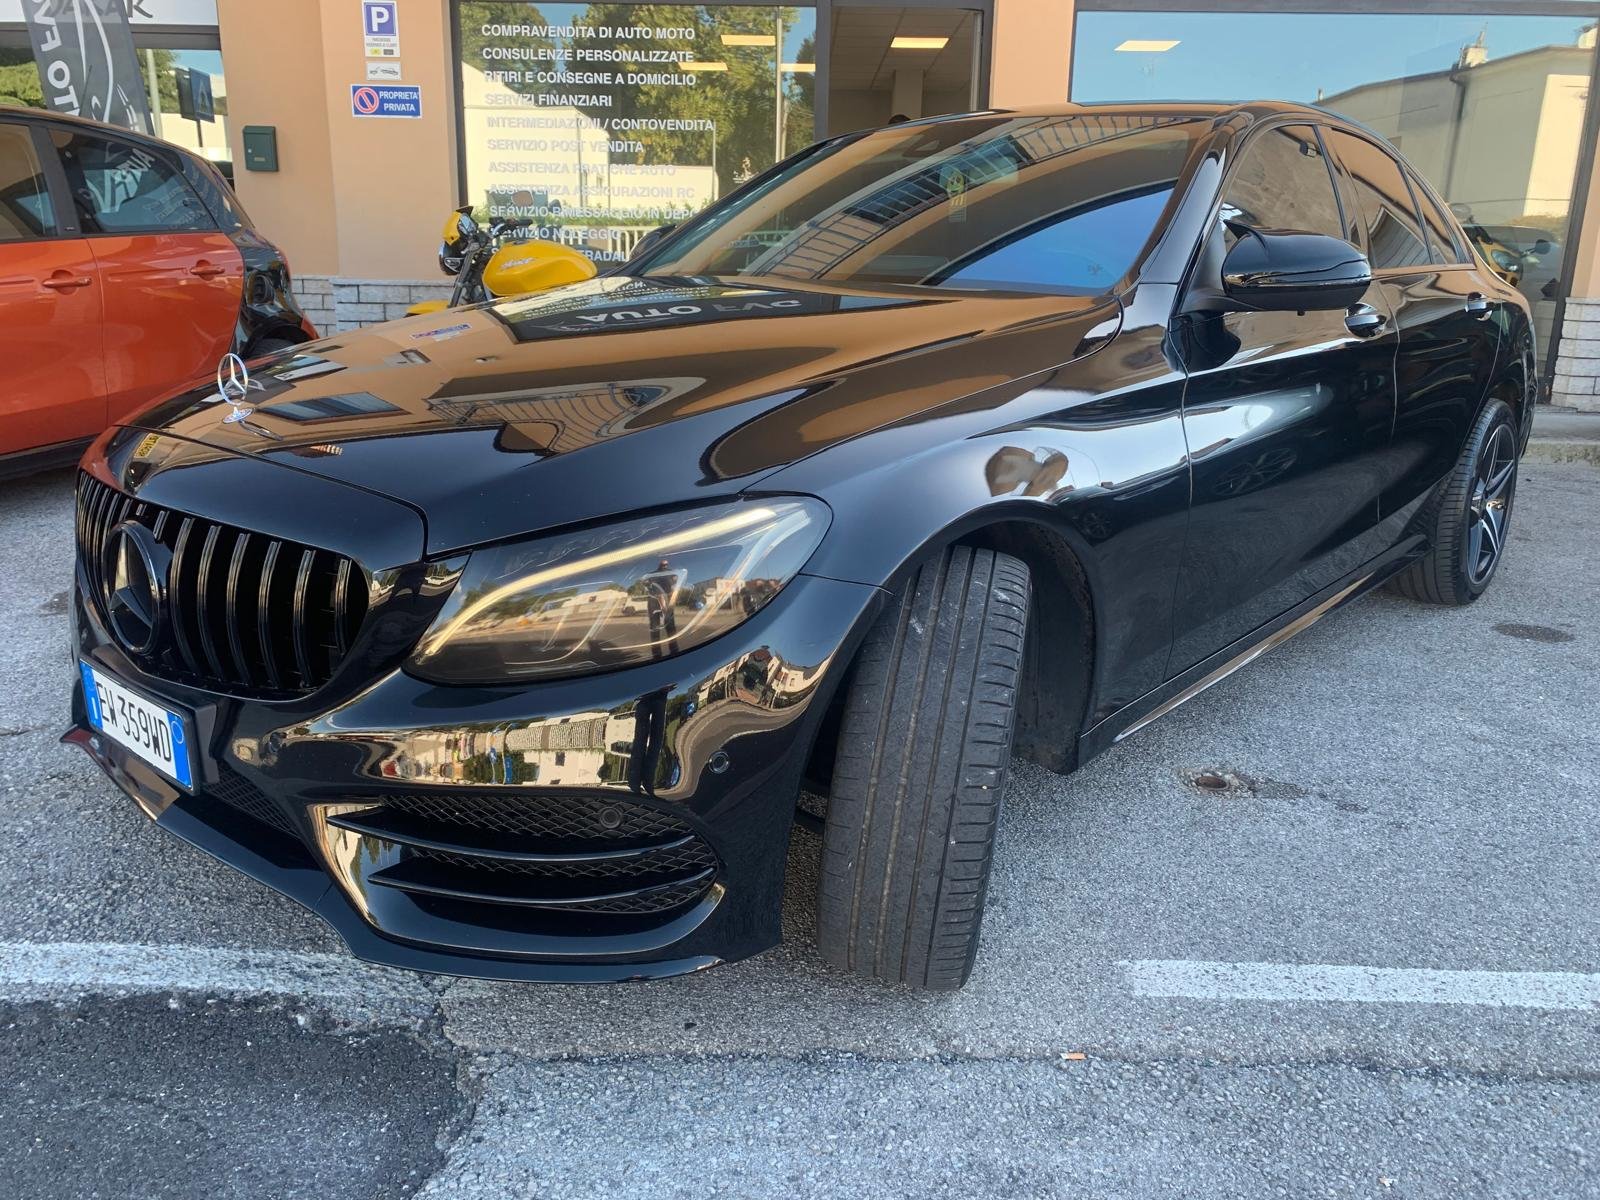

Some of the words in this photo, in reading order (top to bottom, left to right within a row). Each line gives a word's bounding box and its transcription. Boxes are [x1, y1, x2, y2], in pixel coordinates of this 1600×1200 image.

[371, 6, 389, 32] P
[481, 24, 596, 38] COMPRAVENDITA
[599, 27, 612, 39] DI
[616, 27, 652, 40] AUTO
[655, 27, 695, 40] MOTO
[482, 47, 573, 61] CONSULENZE
[576, 49, 694, 63] PERSONALIZZATE
[484, 70, 521, 83] RITIRI
[525, 71, 534, 83] E
[537, 71, 612, 84] CONSEGNE
[615, 72, 625, 85] A
[628, 73, 697, 86] DOMICILIO
[485, 93, 535, 106] SERVIZI
[539, 94, 612, 107] FINANZIARI
[383, 103, 416, 112] PRIVATA
[487, 117, 600, 130] INTERMEDIAZIONI
[611, 118, 715, 131] CONTOVENDITA
[488, 139, 547, 152] SERVIZIO
[551, 140, 586, 152] POST
[591, 140, 644, 153] VENDITA
[489, 162, 569, 174] ASSISTENZA
[573, 163, 635, 176] PRATICHE
[640, 164, 676, 177] AUTO
[489, 184, 571, 197] ASSISTENZA
[574, 185, 678, 198] ASSICURAZIONI
[680, 187, 695, 199] RC
[489, 206, 549, 218] SERVIZIO
[646, 207, 660, 220] IN
[552, 228, 621, 240] NOLEGGIO
